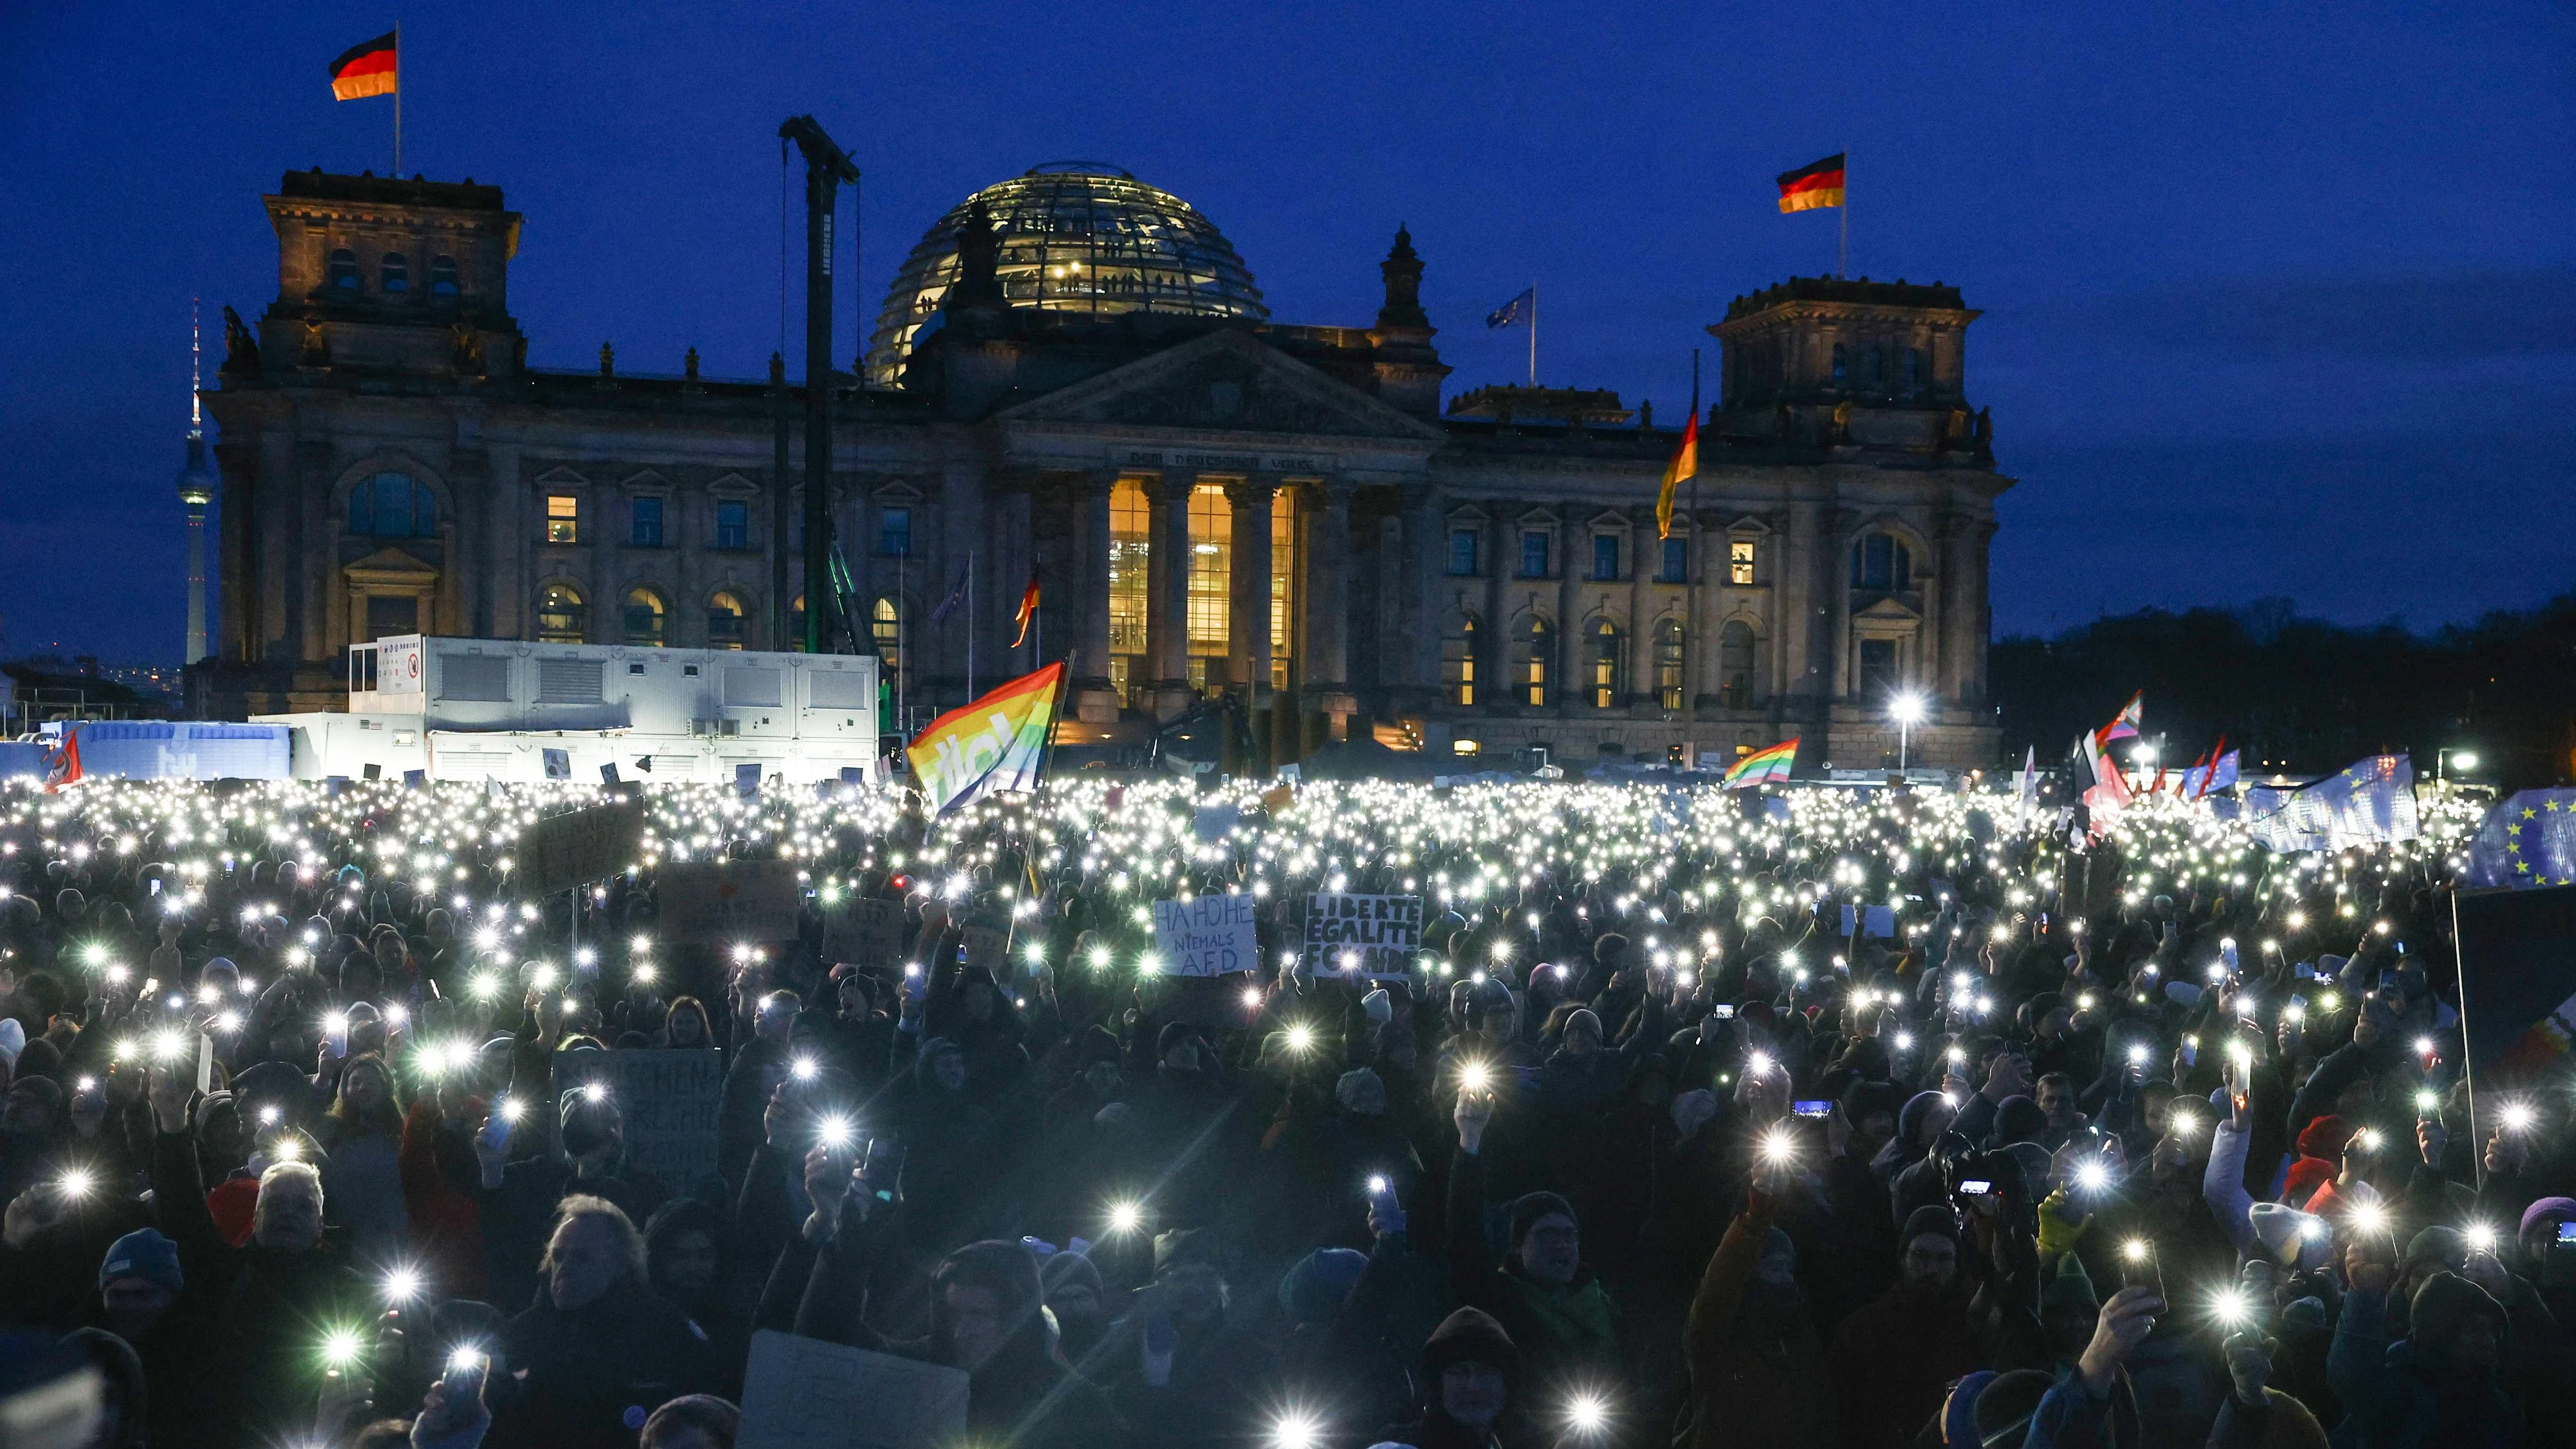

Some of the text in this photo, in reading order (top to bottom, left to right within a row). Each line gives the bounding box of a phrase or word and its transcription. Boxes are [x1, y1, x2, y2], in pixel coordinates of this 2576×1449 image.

[1130, 452, 1315, 470] DEM DEUTSCHEN VOLKE
[1175, 932, 1234, 953] NIEMALS
[1180, 949, 1238, 977] AFD
